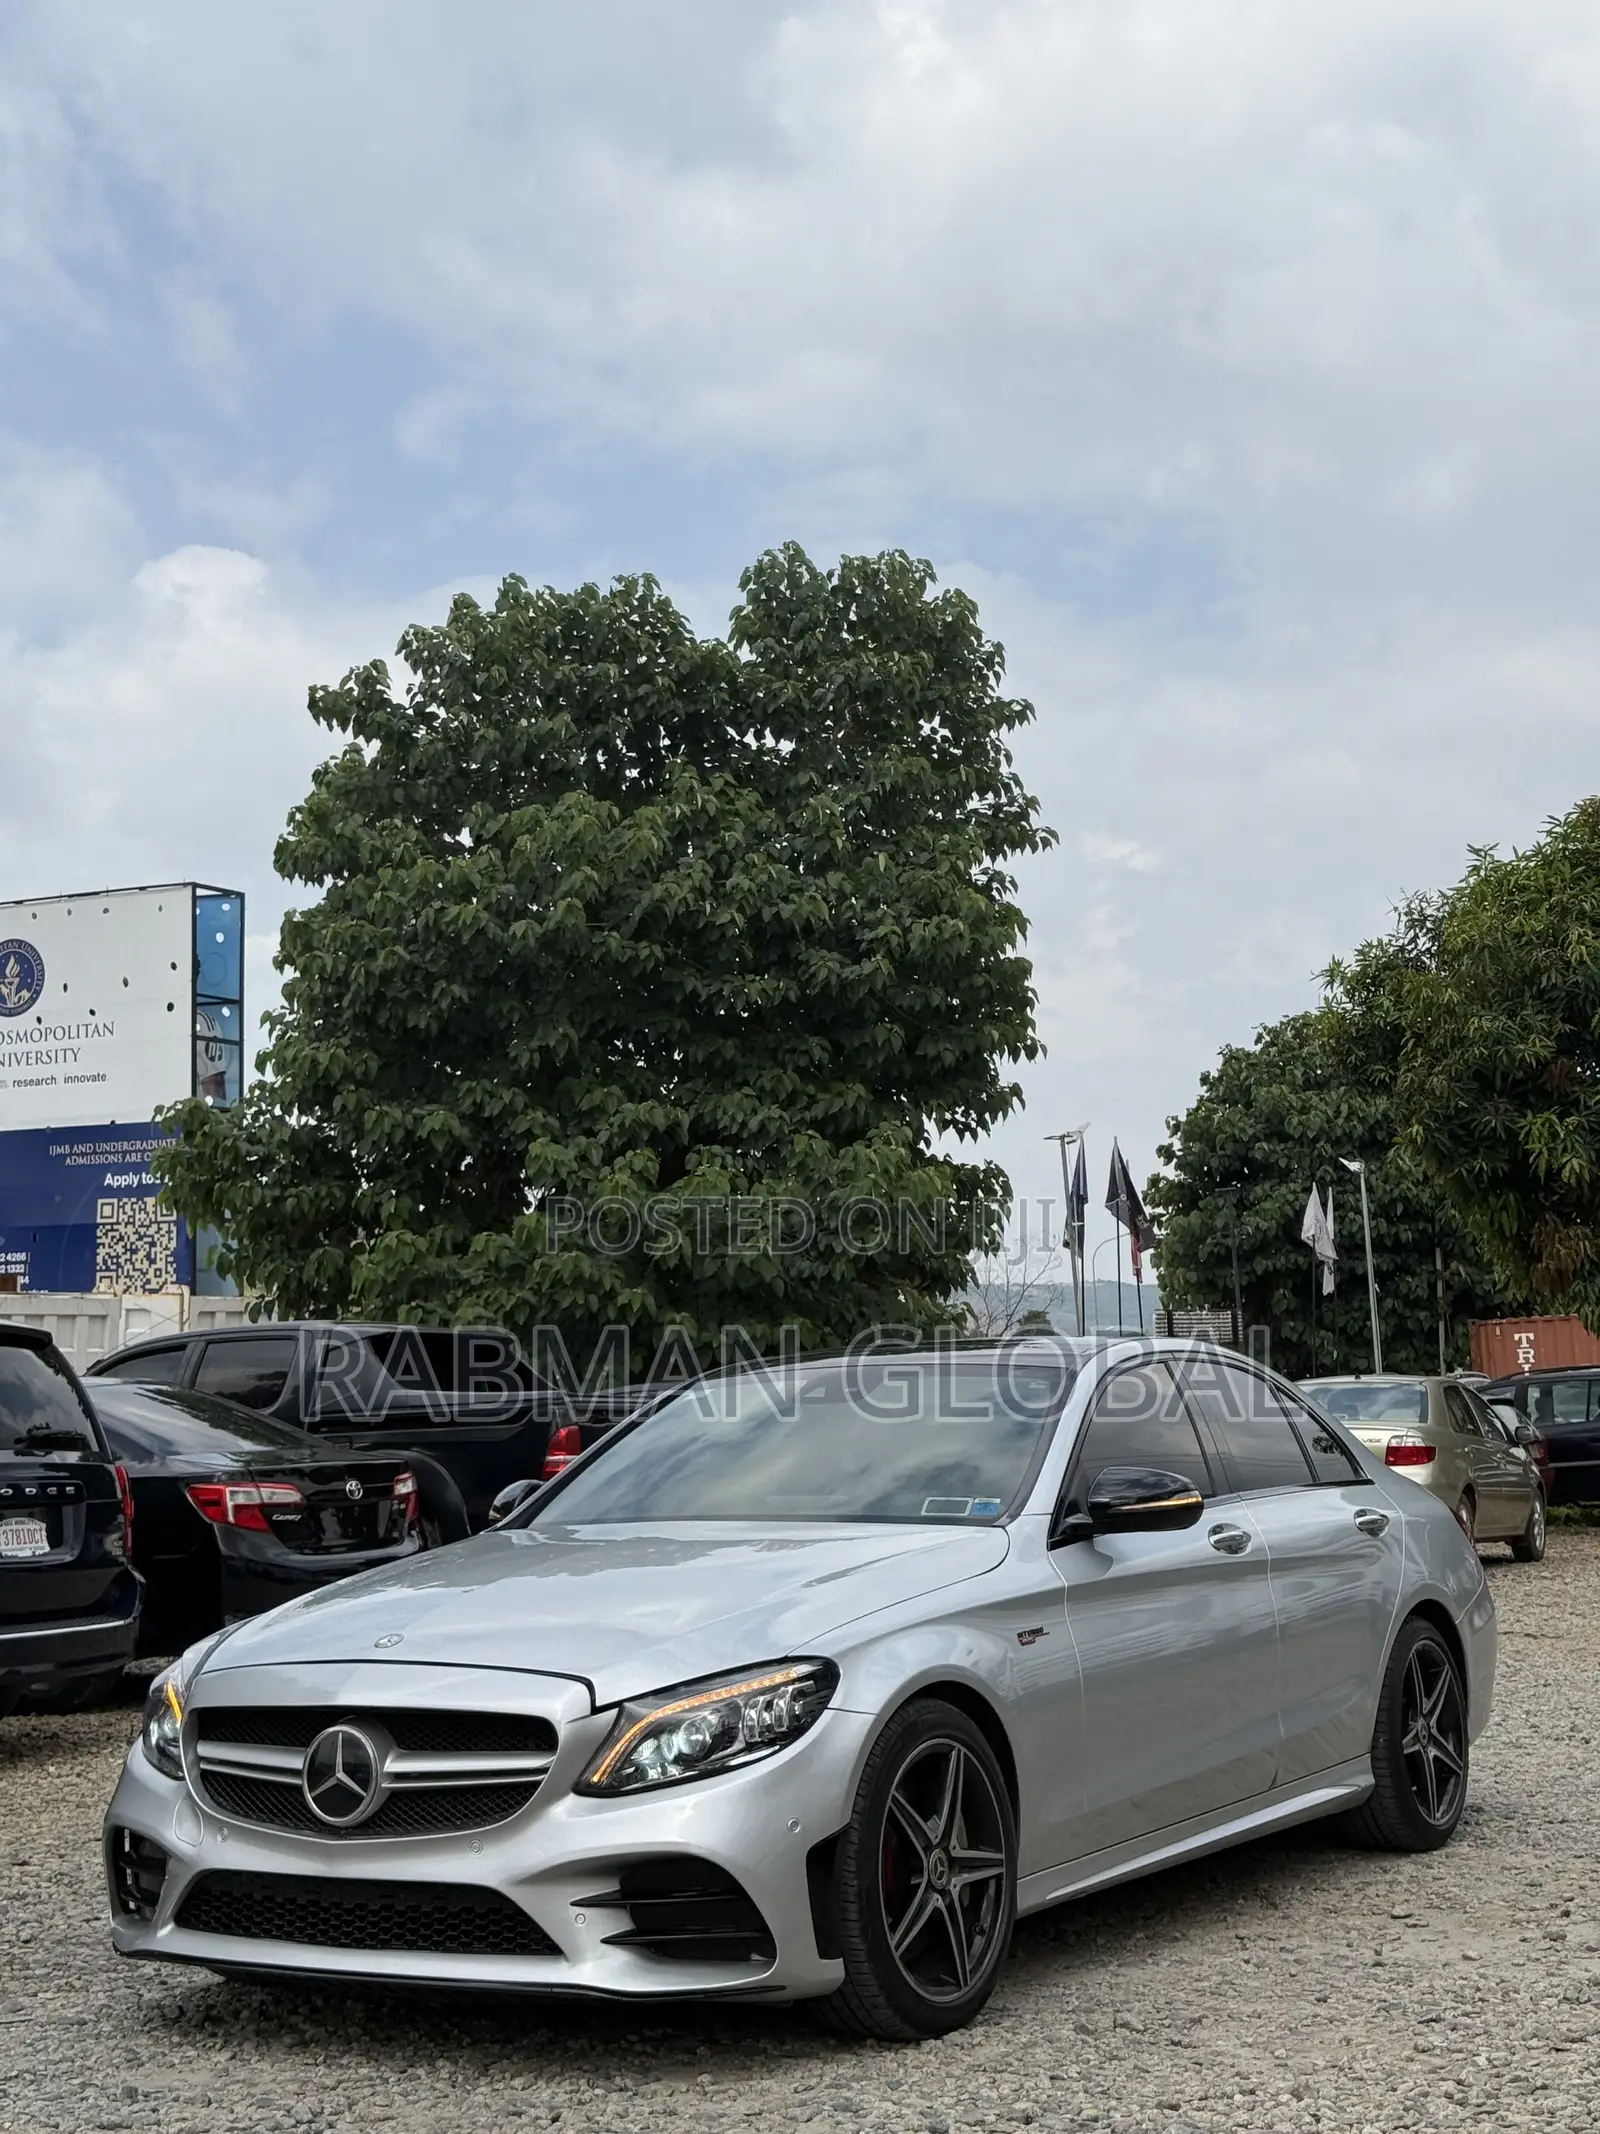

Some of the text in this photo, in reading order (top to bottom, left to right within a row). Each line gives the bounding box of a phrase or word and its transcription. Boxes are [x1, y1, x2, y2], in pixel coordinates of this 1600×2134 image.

[72, 1143, 93, 1154] AND
[65, 1153, 123, 1166] ADMISSIONS
[124, 1151, 142, 1163] ARE
[103, 1172, 140, 1188] Apply
